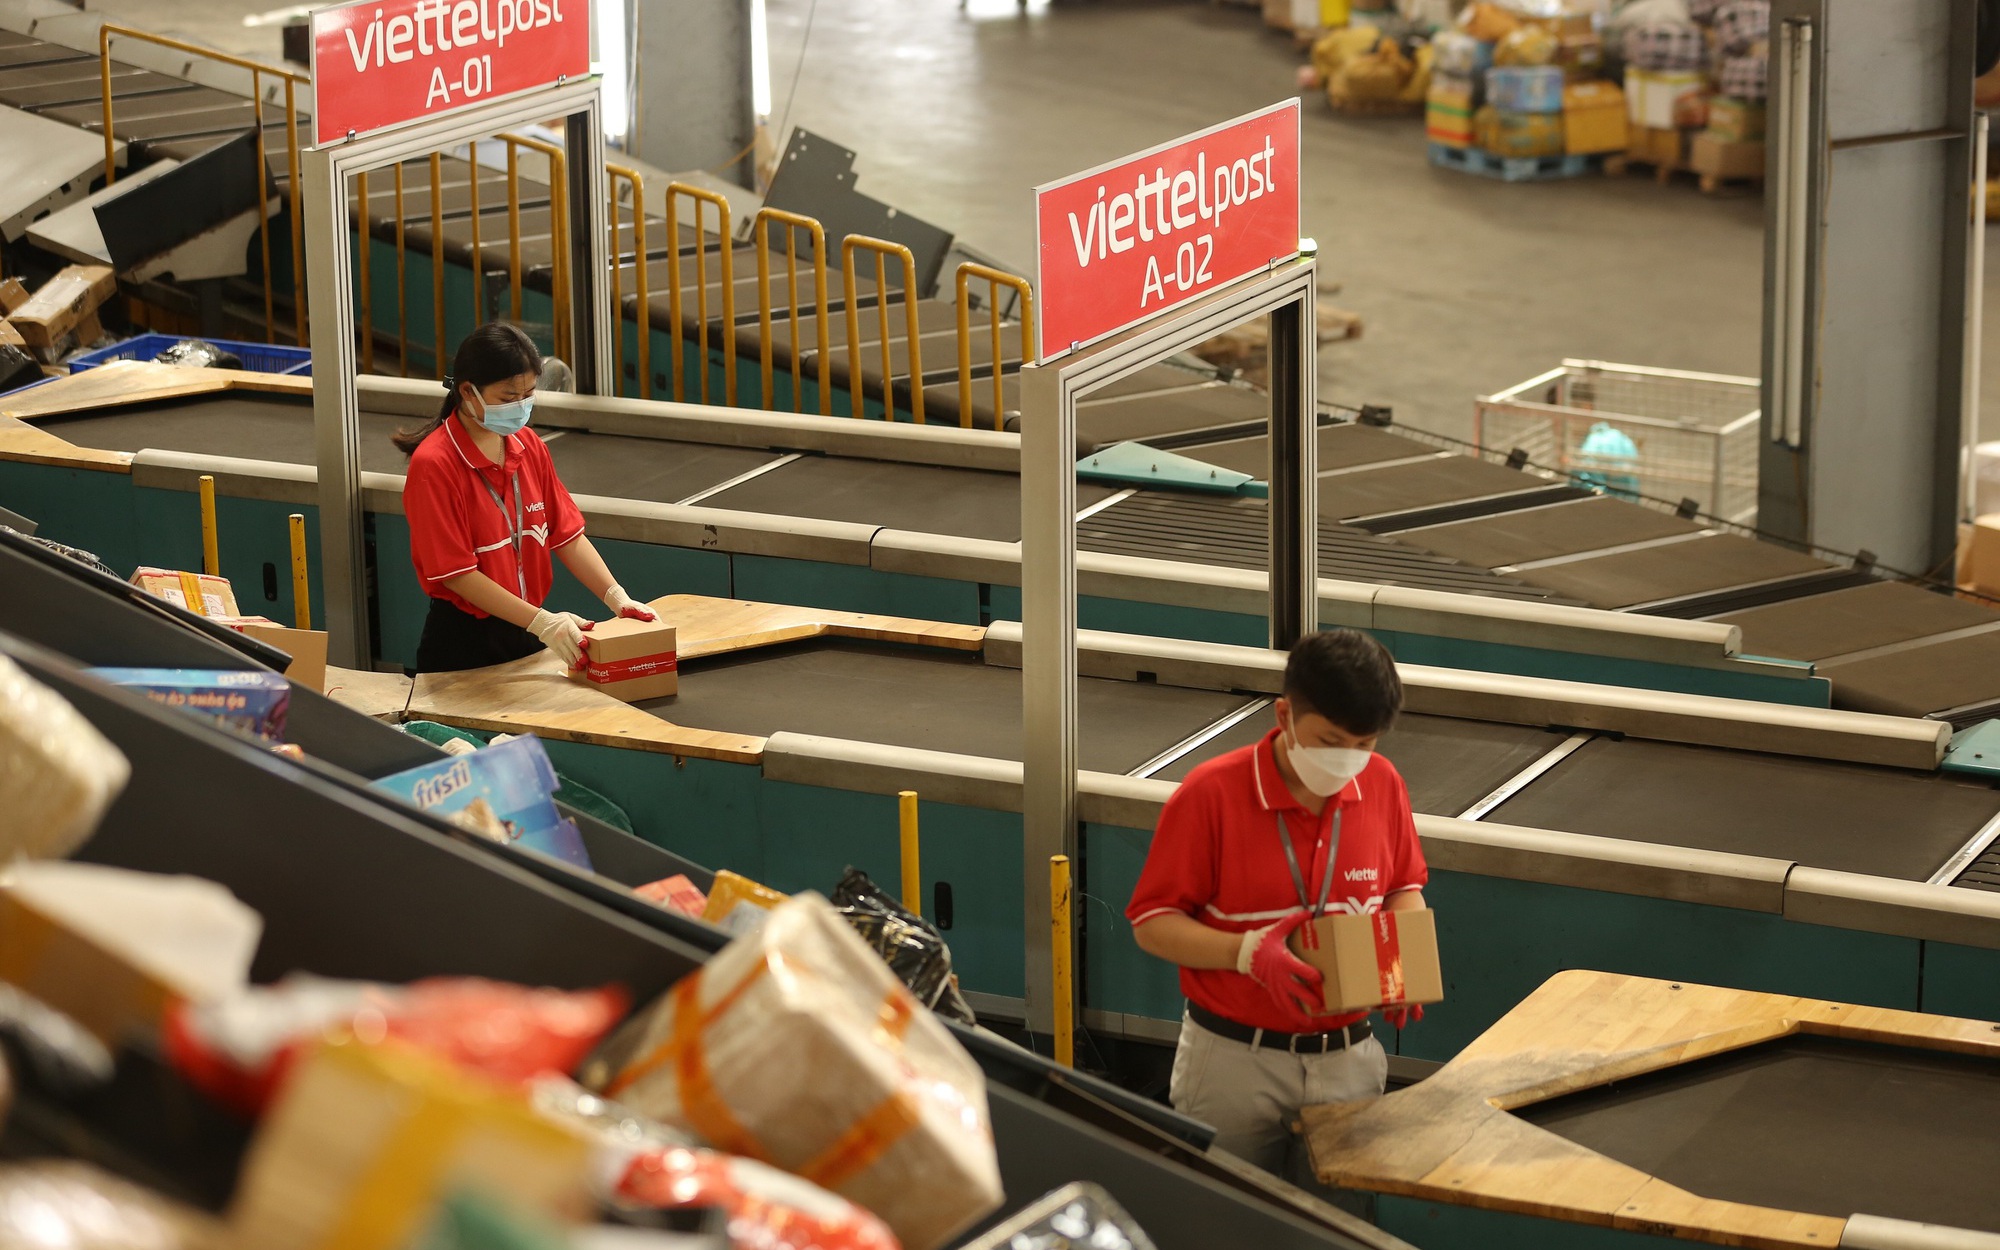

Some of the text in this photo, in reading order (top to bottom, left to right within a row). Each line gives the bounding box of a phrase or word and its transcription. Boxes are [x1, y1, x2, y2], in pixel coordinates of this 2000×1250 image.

[425, 55, 492, 109] A-01
[1140, 234, 1213, 308] A-02
[415, 761, 469, 807] fristi
